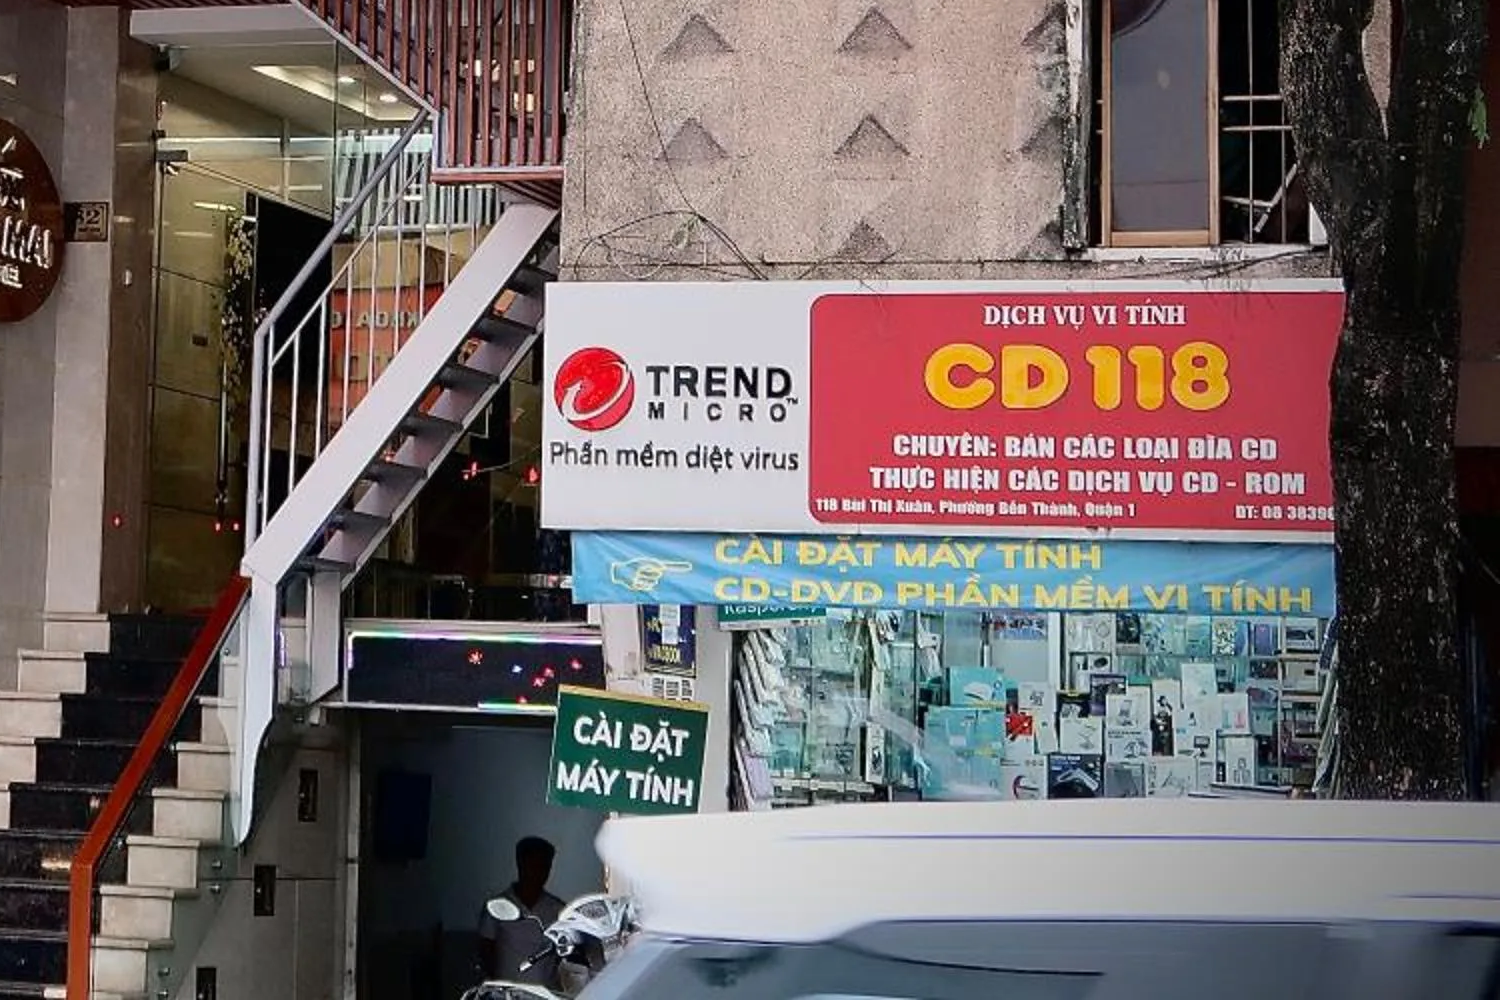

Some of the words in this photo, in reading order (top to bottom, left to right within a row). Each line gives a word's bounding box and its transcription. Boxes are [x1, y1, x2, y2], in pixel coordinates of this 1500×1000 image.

[983, 305, 1046, 329] DỊCH
[1052, 305, 1086, 330] VỤ
[1092, 305, 1117, 325] VI
[1124, 298, 1186, 325] TÍNH
[646, 365, 792, 399] TREND
[924, 342, 1070, 410] CD
[1086, 341, 1232, 411] 118
[648, 402, 788, 423] MICRO
[686, 444, 734, 473] diệt
[739, 447, 799, 471] virus
[893, 432, 998, 458] CHUYÊN:
[1004, 433, 1056, 459] BÁN
[1063, 433, 1115, 459] CÁC
[1123, 436, 1180, 463] LOẠI
[1241, 437, 1278, 461] CD
[870, 464, 937, 493] THỰC
[943, 465, 1000, 495] HIỆN
[1008, 466, 1059, 492] CÁC
[1067, 469, 1131, 497] DỊCH
[1138, 471, 1174, 497] VỤ
[1182, 471, 1220, 493] CD
[1245, 472, 1306, 496] ROM
[816, 498, 838, 512] 118
[870, 499, 893, 515] Thị
[1128, 503, 1136, 517] 1
[796, 535, 882, 574] ĐẶT
[895, 538, 986, 569] MÁY
[996, 539, 1102, 569] TÍNH
[713, 576, 884, 605] CD-DVD
[897, 572, 1019, 608] PHẦN
[1034, 574, 1133, 611] MỀM
[1143, 585, 1190, 611] VI
[1203, 580, 1314, 614] TÍNH
[573, 710, 622, 749] CÀI
[629, 717, 690, 763] ĐẶT
[556, 758, 622, 796] MÁY
[624, 763, 694, 807] TÍNH
